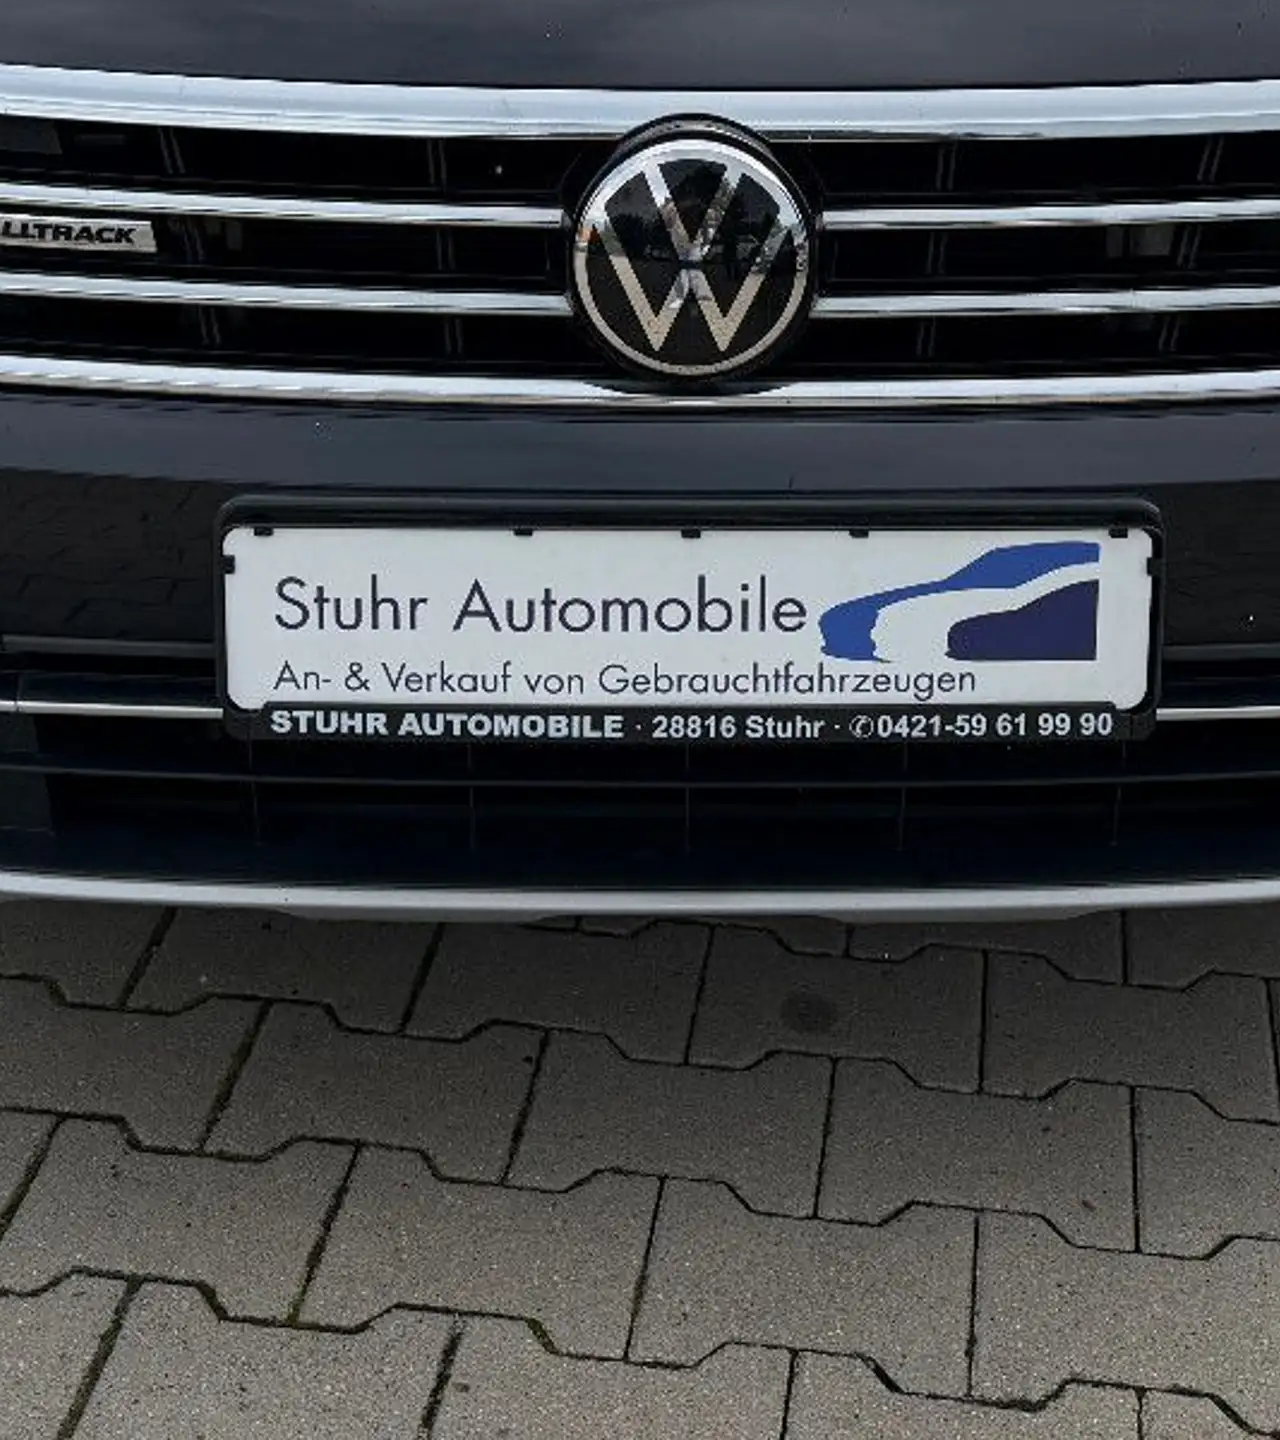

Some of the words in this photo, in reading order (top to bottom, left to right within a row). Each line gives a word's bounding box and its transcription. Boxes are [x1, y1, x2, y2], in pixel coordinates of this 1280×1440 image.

[274, 573, 429, 632] Stuhr
[452, 573, 808, 634] Automobile
[272, 660, 332, 692] An-
[343, 662, 371, 693] &
[381, 660, 512, 694] Verkauf
[524, 672, 585, 696] von
[598, 660, 976, 702] Gebrauchtfahrzeugen
[270, 710, 394, 736] STUHR
[398, 711, 625, 739] AUTOMOBILE
[651, 715, 736, 739] 28816
[745, 715, 824, 739] Stuhr
[995, 713, 1027, 737] 61
[1037, 713, 1071, 737] 99
[1079, 712, 1114, 737] 90
